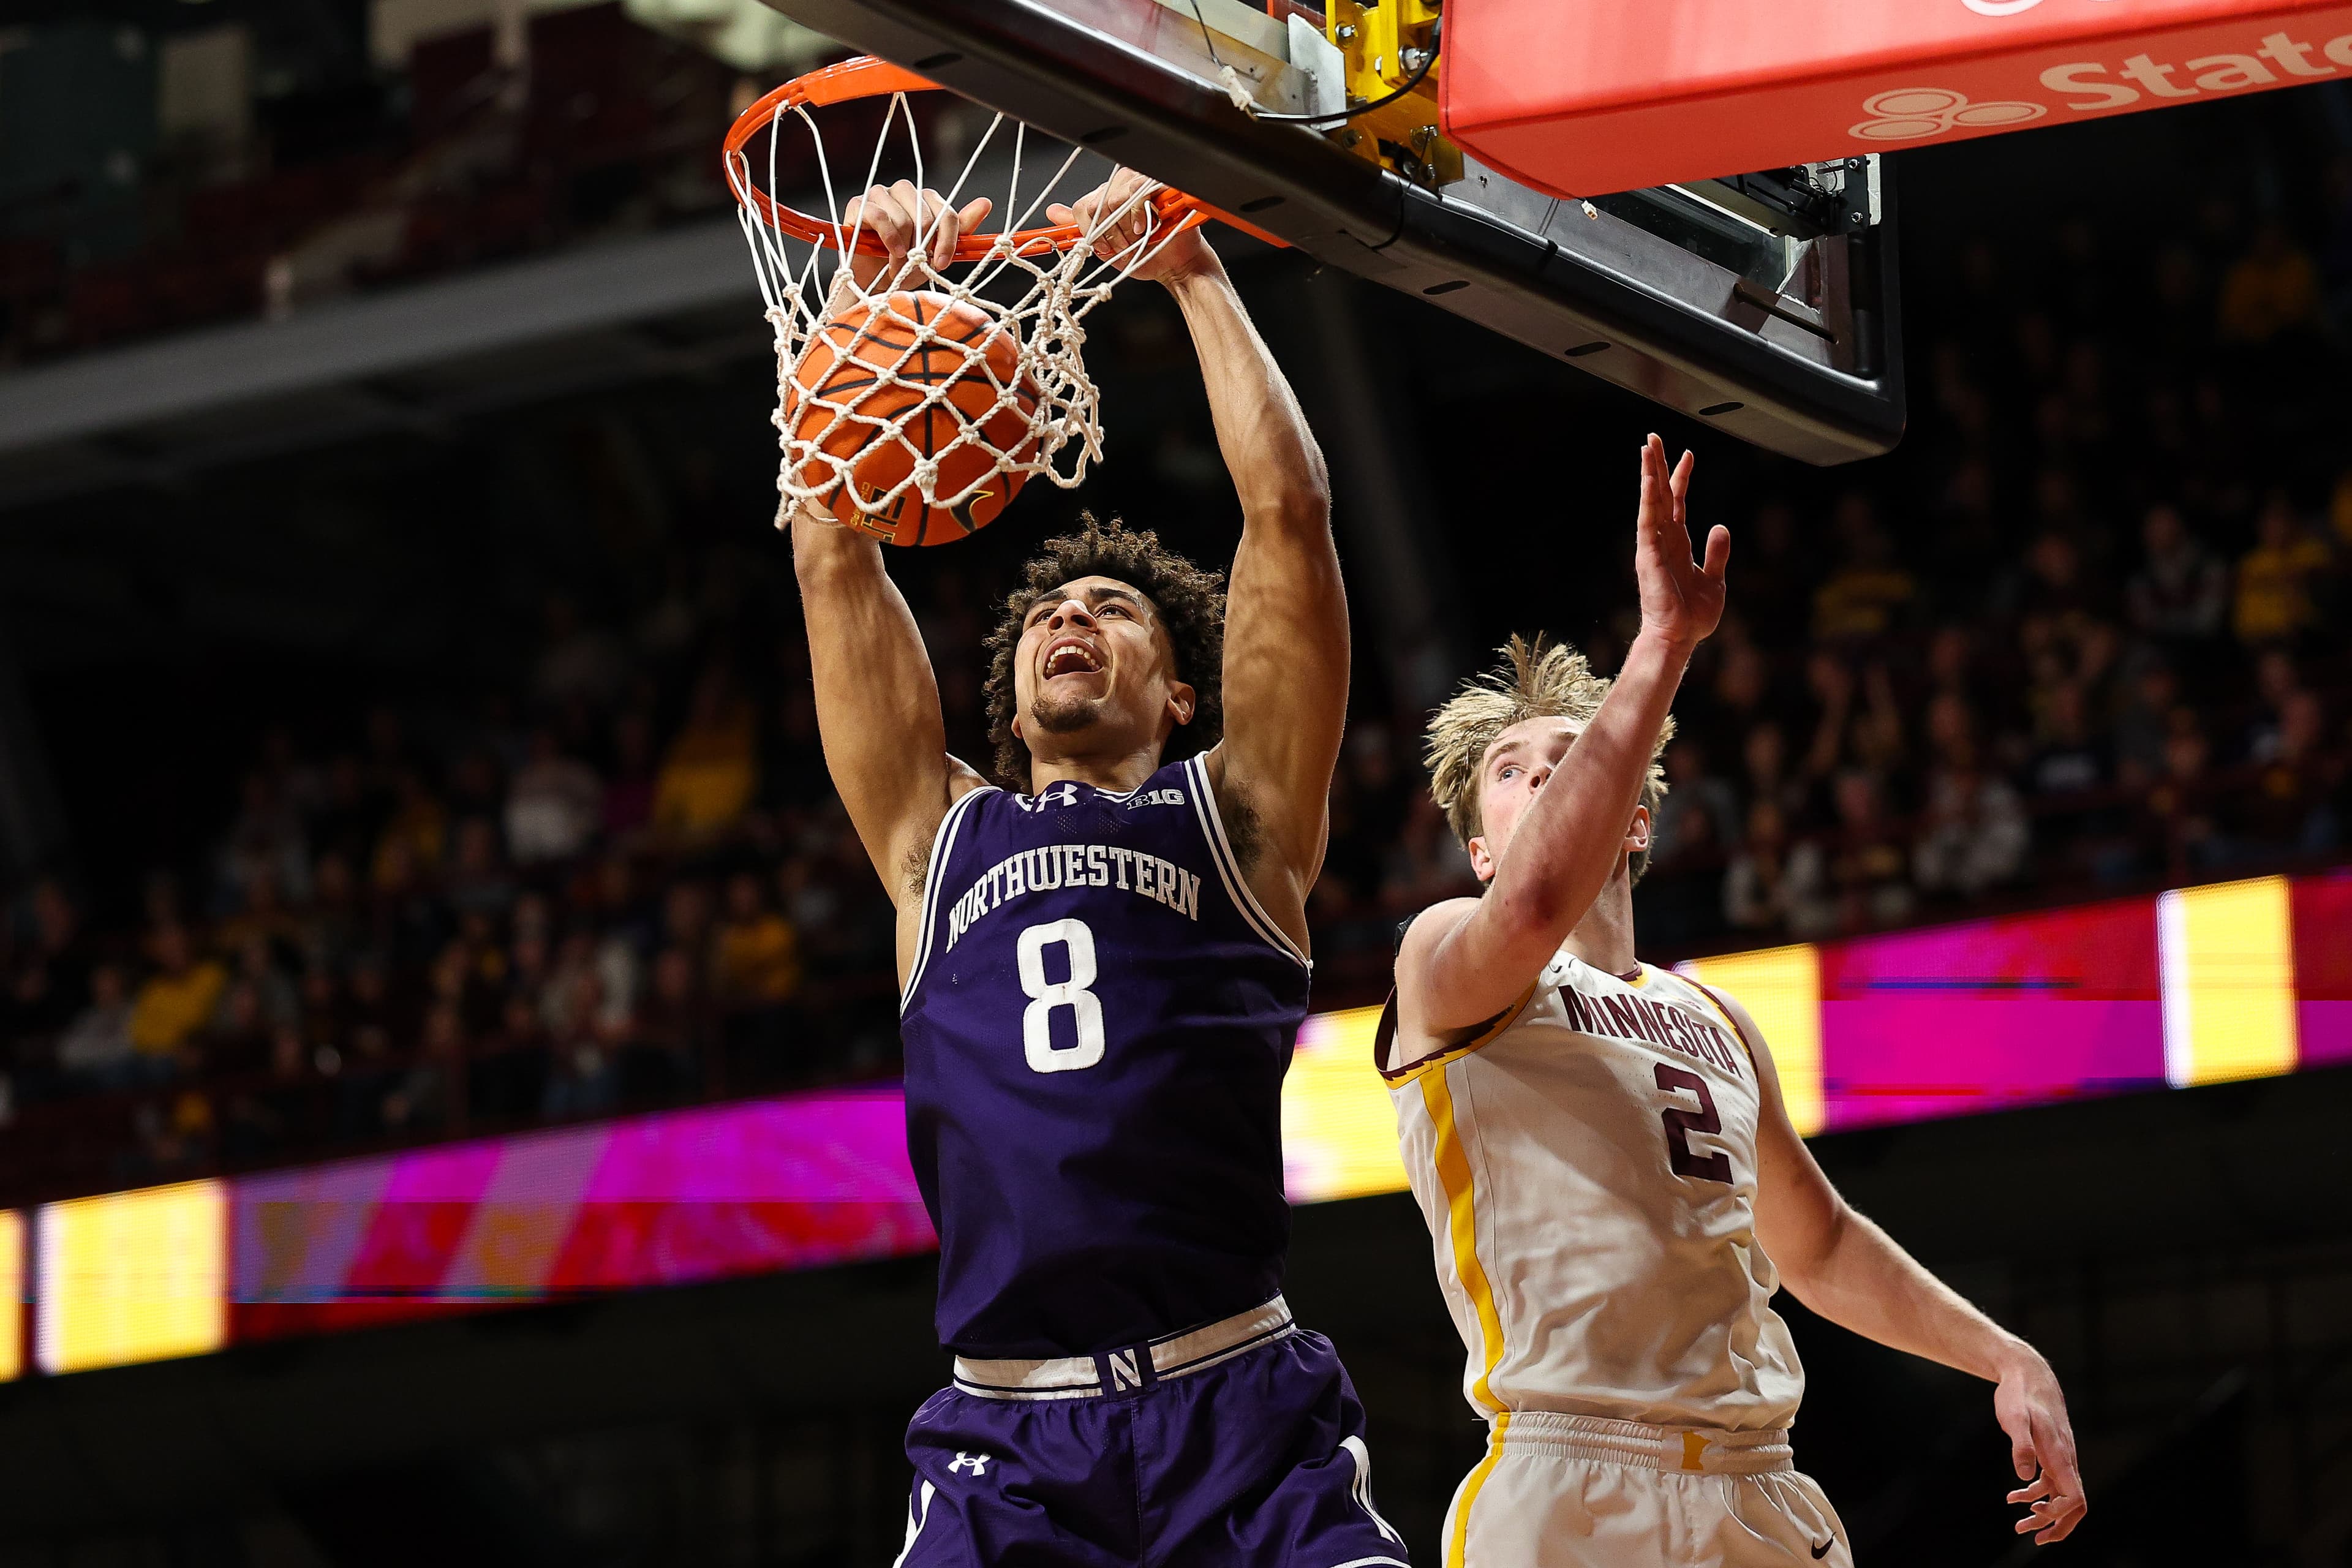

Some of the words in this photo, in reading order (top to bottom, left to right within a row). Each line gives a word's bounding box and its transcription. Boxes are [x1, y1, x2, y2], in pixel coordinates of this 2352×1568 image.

[945, 844, 1201, 954] NORTHWESTERN
[1017, 918, 1106, 1073] 8
[1653, 1061, 1735, 1185] 2
[1108, 1348, 1142, 1392] N
